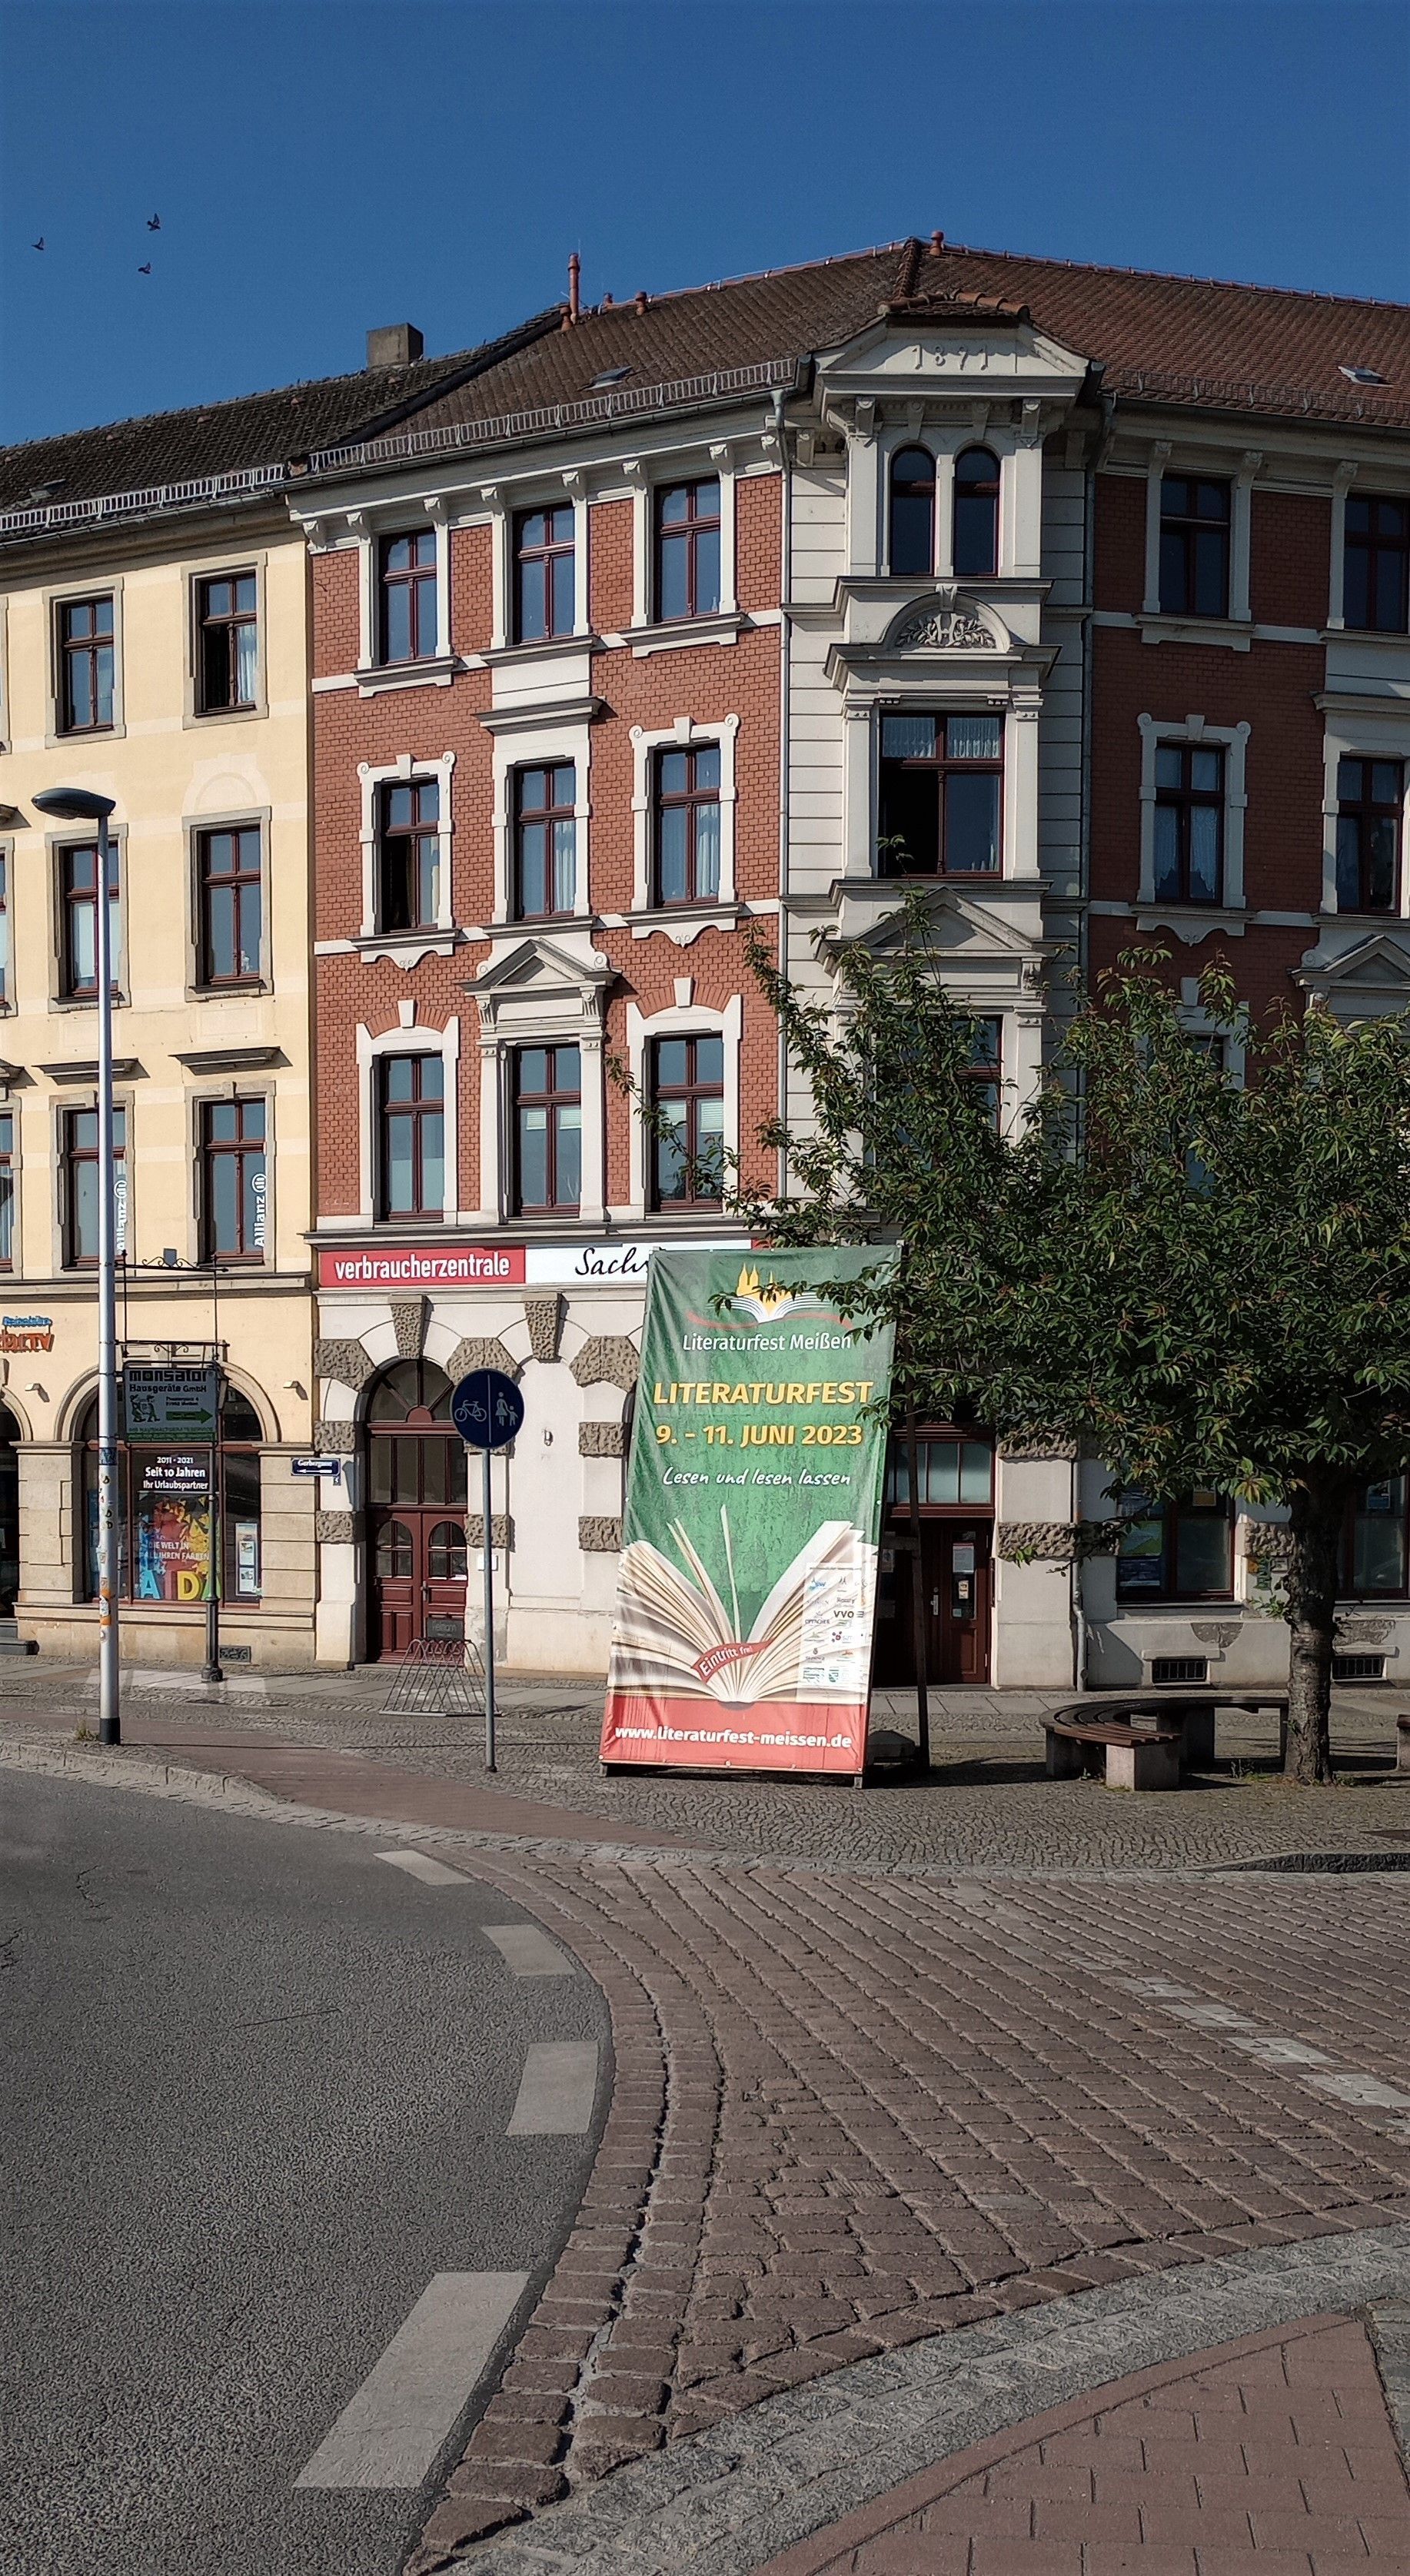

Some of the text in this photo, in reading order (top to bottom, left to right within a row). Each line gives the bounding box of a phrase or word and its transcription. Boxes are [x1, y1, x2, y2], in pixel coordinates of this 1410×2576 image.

[911, 344, 989, 371] 1871
[254, 1195, 264, 1247] Allianz
[334, 1251, 510, 1280] verbraucherzentrale
[574, 1247, 649, 1275] Sach
[683, 1331, 852, 1351] Literaturfest Meißen
[129, 1371, 207, 1382] monsator
[653, 1381, 874, 1405] LITERATURFEST
[656, 1425, 677, 1445] 9.
[703, 1425, 734, 1445] 11.
[740, 1425, 795, 1448] JUNI
[801, 1425, 863, 1445] 2023
[145, 1466, 206, 1477] Seit 10 Jahren
[662, 1466, 851, 1485] Lesen und lesen lassen
[142, 1480, 208, 1491] Ihr Urlaubspartner
[833, 1610, 854, 1618] VVO
[699, 1647, 739, 1677] Eintritt
[614, 1726, 853, 1748] www.literaturfest-meissen.de
